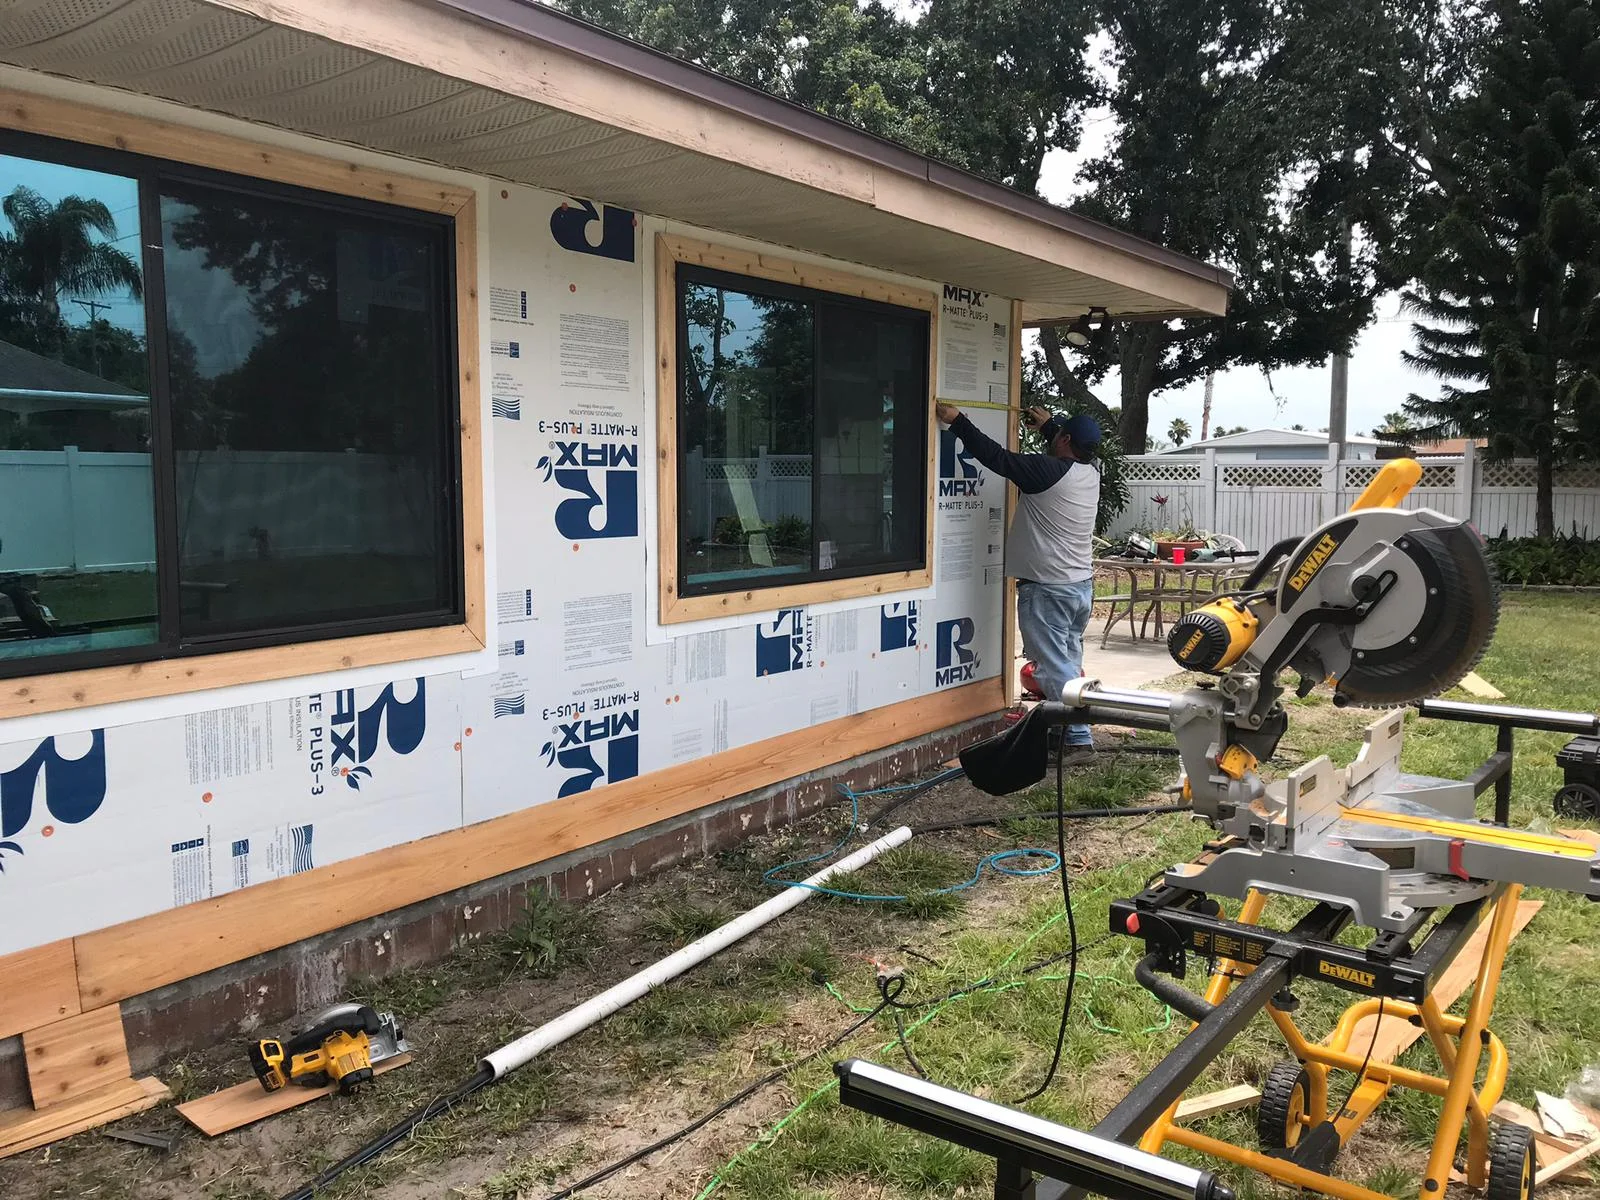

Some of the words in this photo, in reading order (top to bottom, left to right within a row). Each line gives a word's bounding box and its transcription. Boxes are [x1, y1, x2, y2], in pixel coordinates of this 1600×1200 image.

[944, 284, 981, 307] MAX
[969, 310, 989, 322] PLUS-3
[538, 420, 582, 434] PLUS-3
[591, 423, 638, 436] R-MATTE
[555, 441, 638, 467] MAX
[939, 480, 977, 497] MAX
[554, 469, 638, 540] R
[965, 500, 984, 510] PLUS-3
[1289, 534, 1338, 592] DEWALT
[936, 617, 975, 669] R
[1179, 629, 1205, 660] DEWALT
[936, 663, 974, 688] MAX
[572, 687, 598, 696] INSULATION
[593, 690, 640, 710] R-MATTE
[542, 701, 585, 720] PLUS-3
[295, 708, 303, 752] INSULATION
[331, 688, 356, 767] AX
[558, 709, 639, 749] MAX
[310, 727, 324, 796] PLUS-3
[1320, 960, 1376, 988] DEWALT
